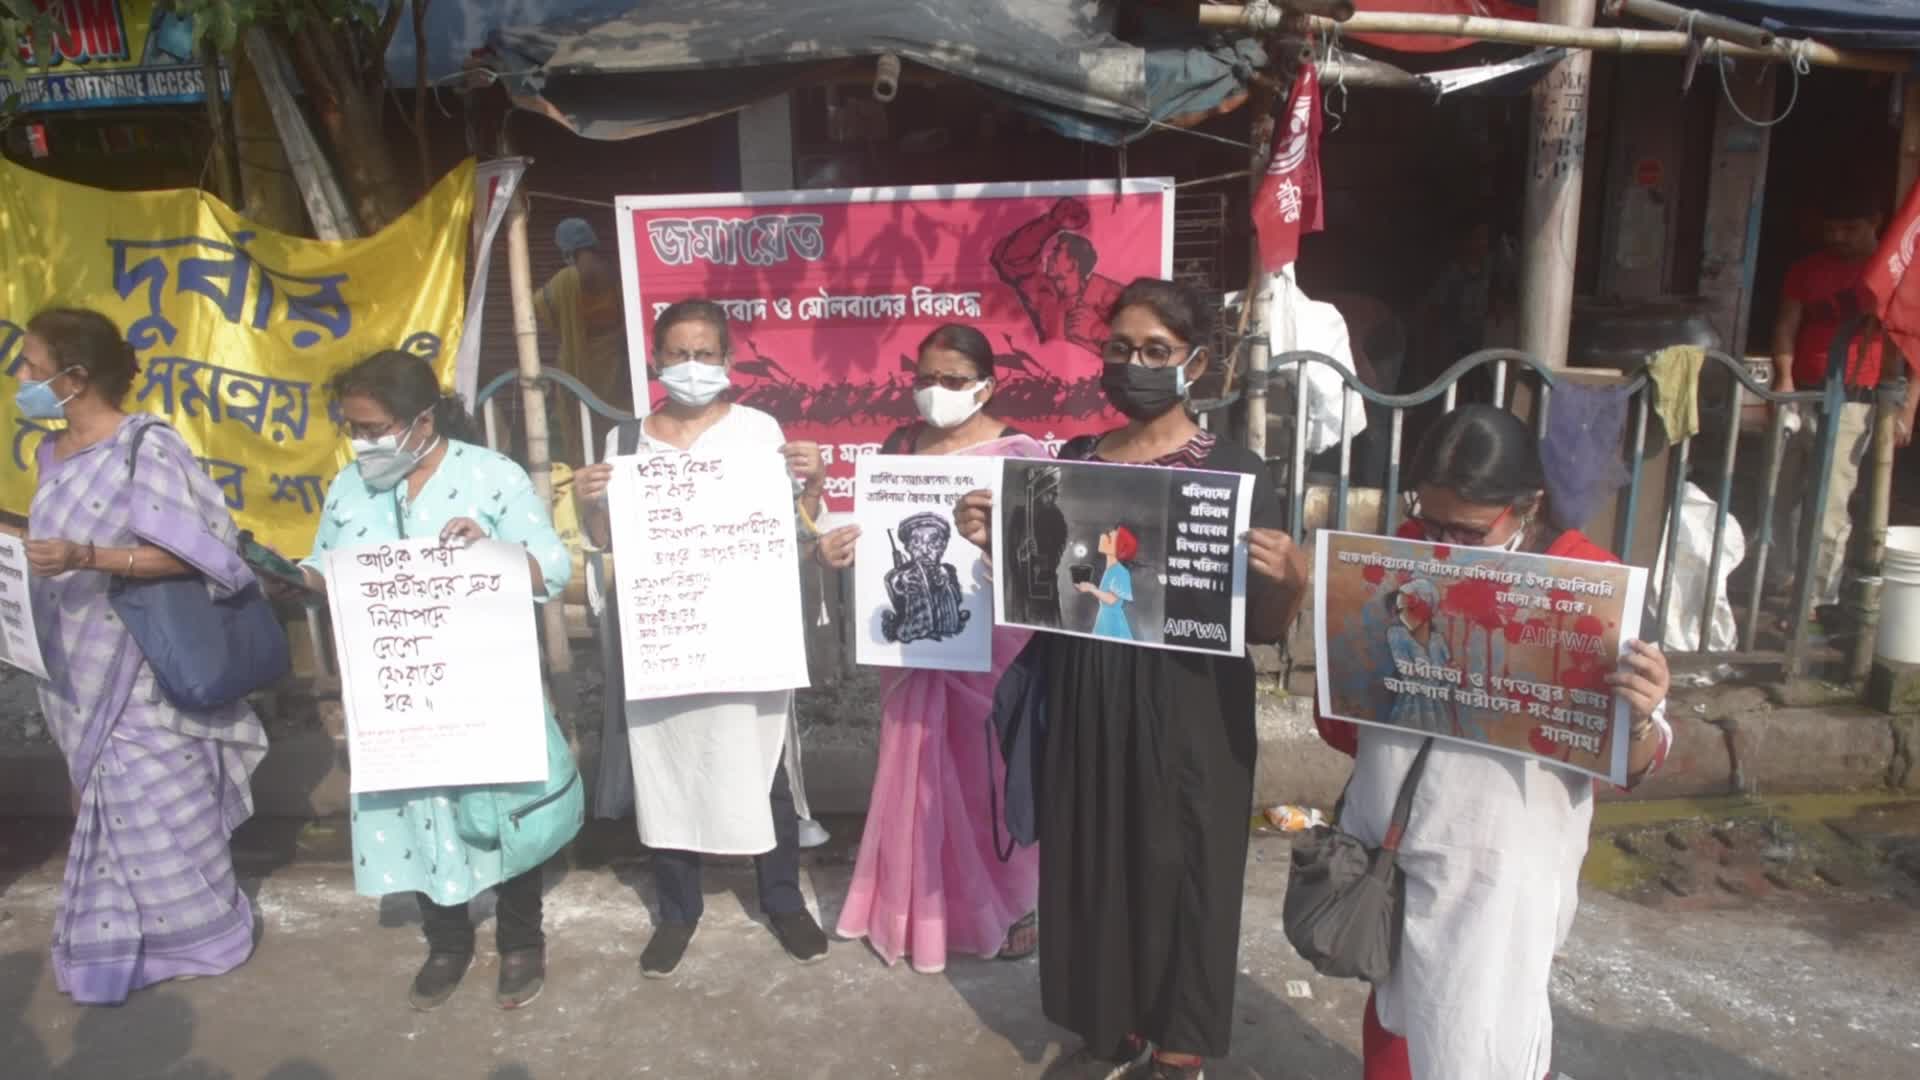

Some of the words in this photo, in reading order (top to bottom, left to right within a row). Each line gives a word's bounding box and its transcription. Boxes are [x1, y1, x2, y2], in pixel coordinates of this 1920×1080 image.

[65, 74, 144, 101] SOFTWARE
[647, 212, 824, 266] জমায়েত
[107, 231, 352, 350] দুর্বার
[773, 298, 792, 320] ও
[798, 286, 906, 320] মৌলবাদের
[912, 286, 981, 318] বিরুদ্ধে
[137, 356, 312, 442] সমন্বয়
[1163, 617, 1228, 642] AIPWA
[1520, 625, 1608, 656] AIPWA
